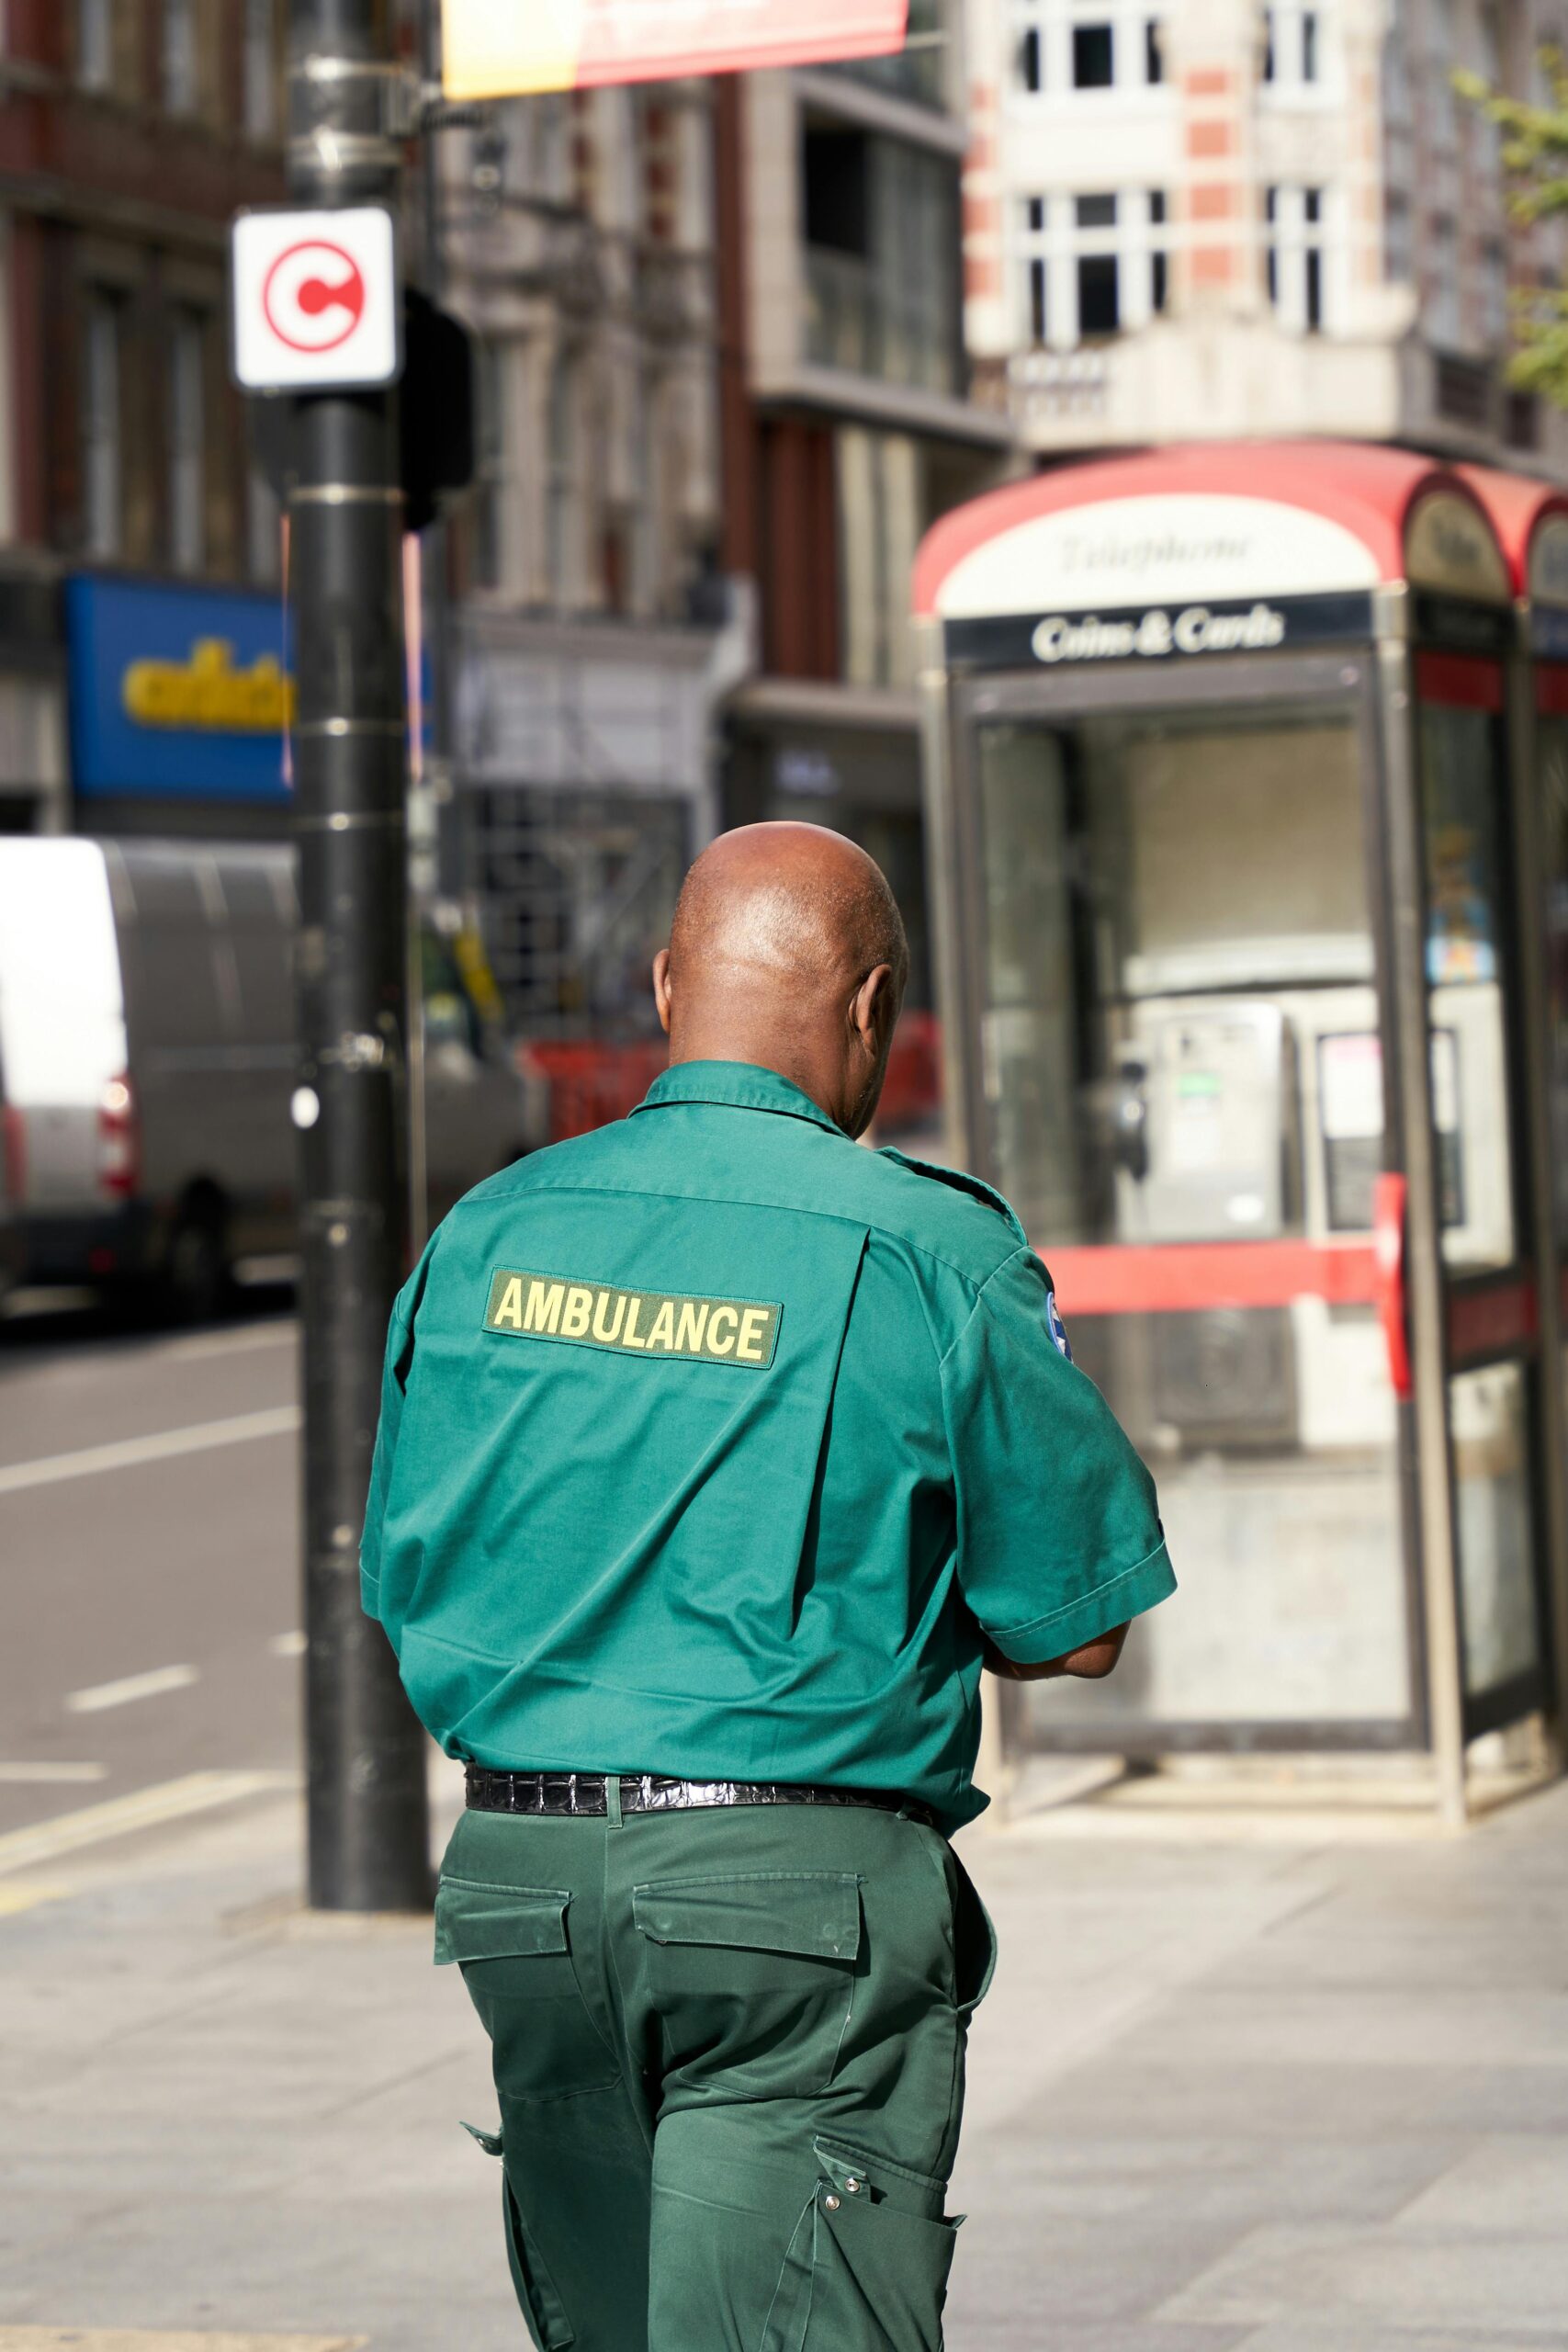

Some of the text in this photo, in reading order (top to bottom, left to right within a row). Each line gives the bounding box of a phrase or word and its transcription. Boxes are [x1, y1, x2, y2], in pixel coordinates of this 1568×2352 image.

[1032, 604, 1285, 662] Coins & Cards
[493, 1277, 770, 1360] AMBULANCE
